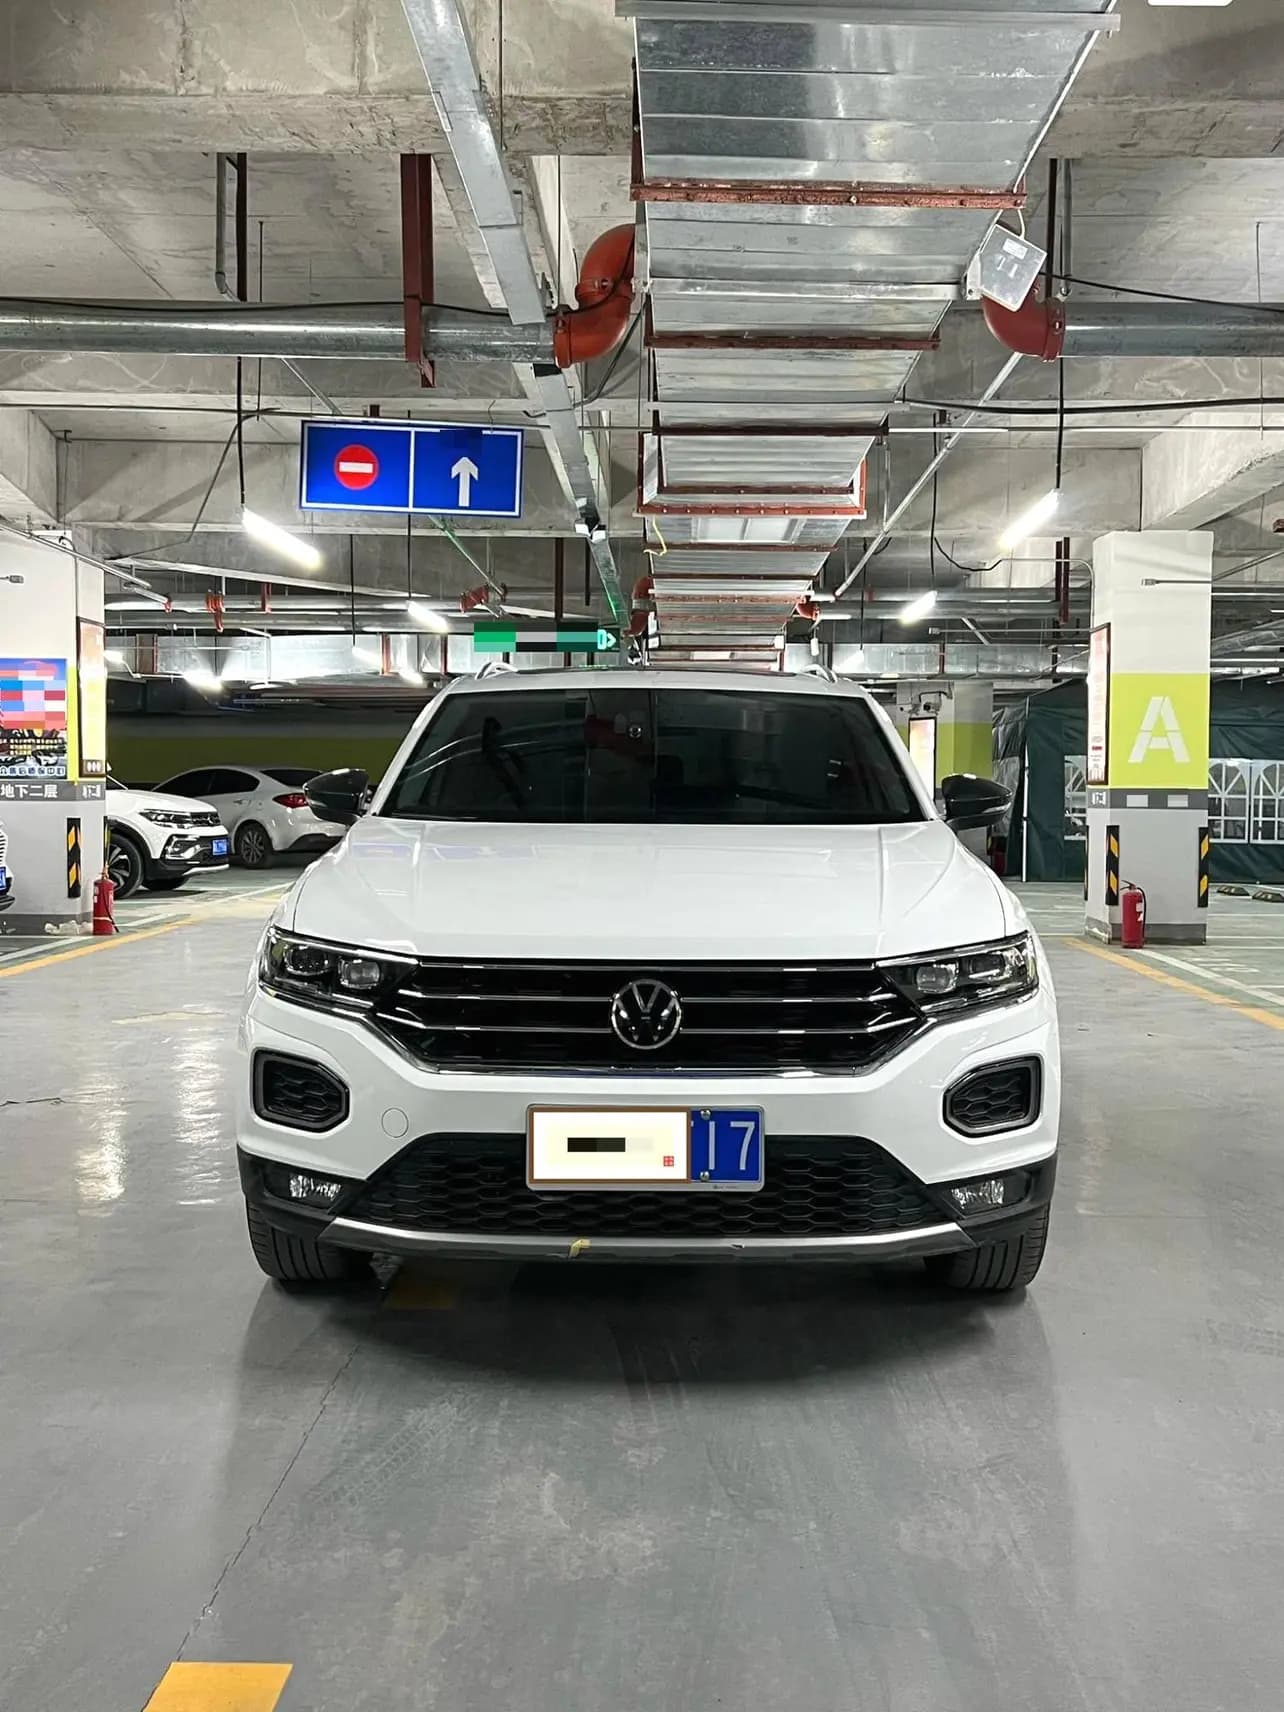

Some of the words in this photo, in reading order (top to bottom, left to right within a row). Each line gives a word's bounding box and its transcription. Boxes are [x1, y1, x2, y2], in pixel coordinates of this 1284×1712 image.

[1128, 695, 1190, 763] A
[0, 784, 58, 798] 地下二层
